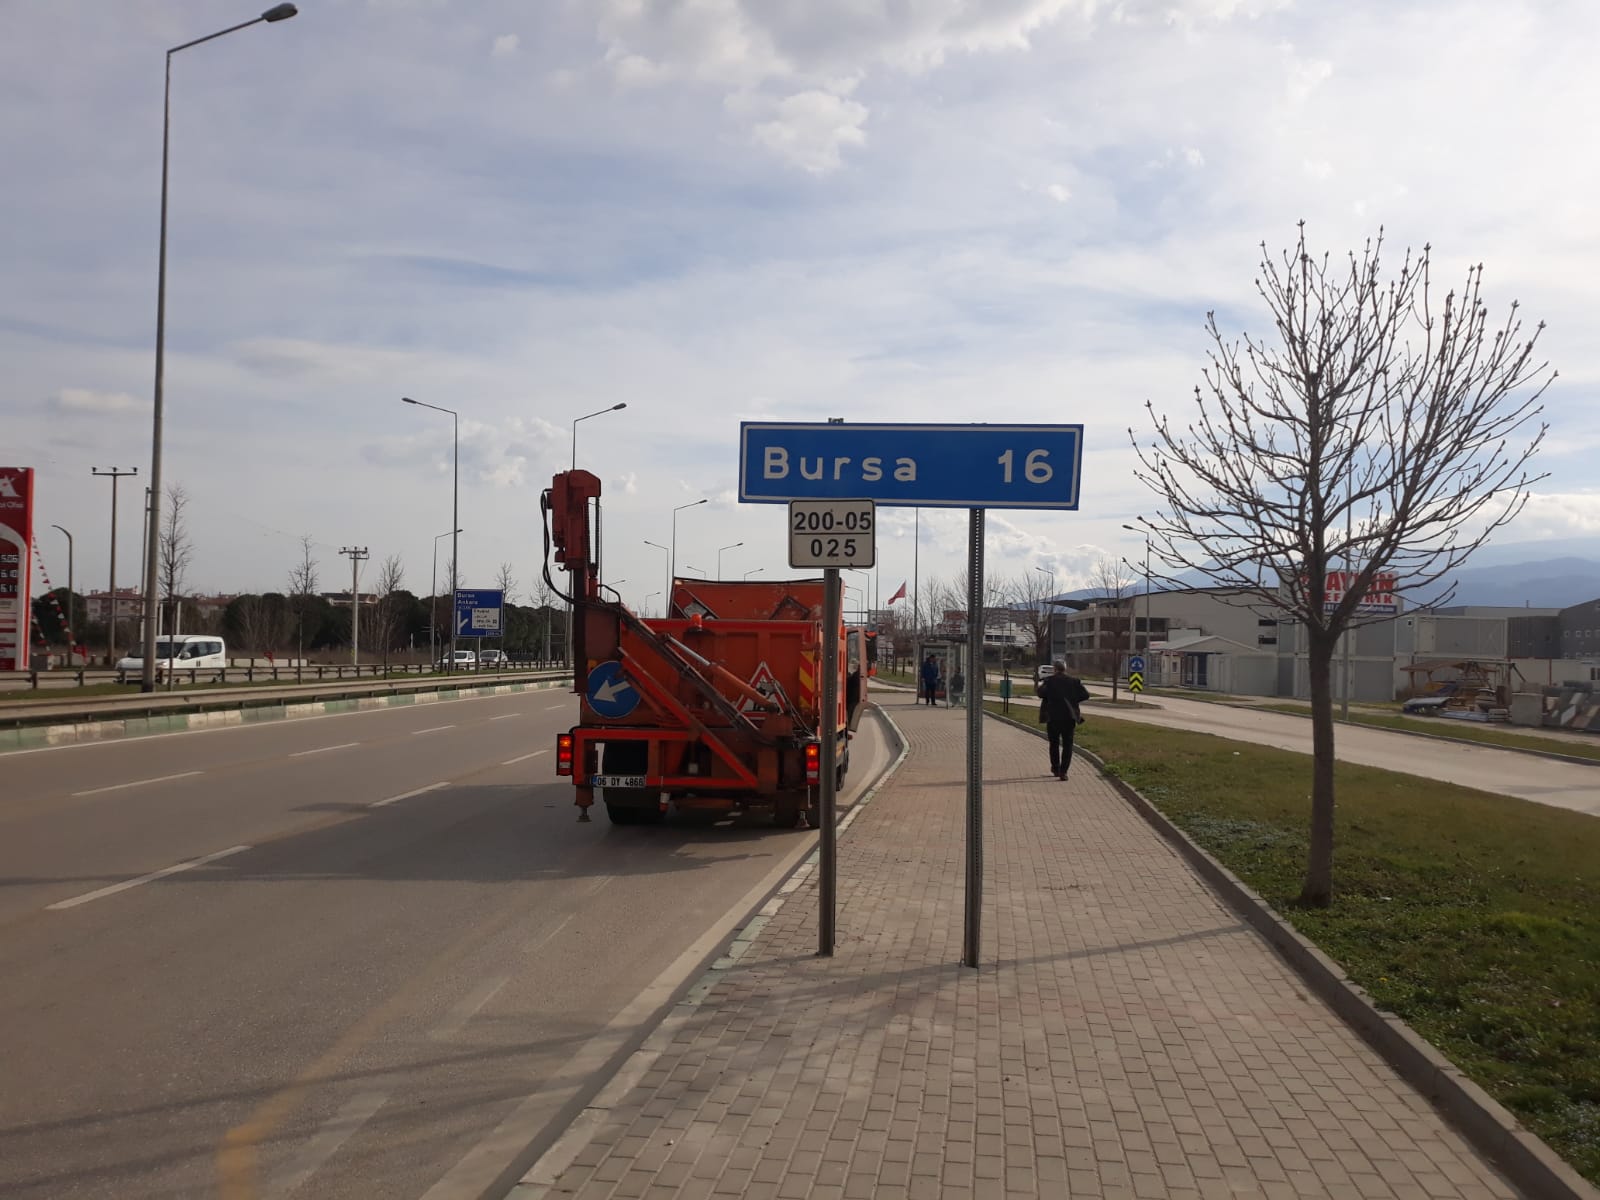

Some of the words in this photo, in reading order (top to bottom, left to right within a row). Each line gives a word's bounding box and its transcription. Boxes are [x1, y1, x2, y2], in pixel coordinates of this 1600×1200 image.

[763, 446, 917, 482] Bursa
[997, 449, 1054, 484] 16
[793, 511, 872, 532] 200-05
[810, 538, 857, 557] 025
